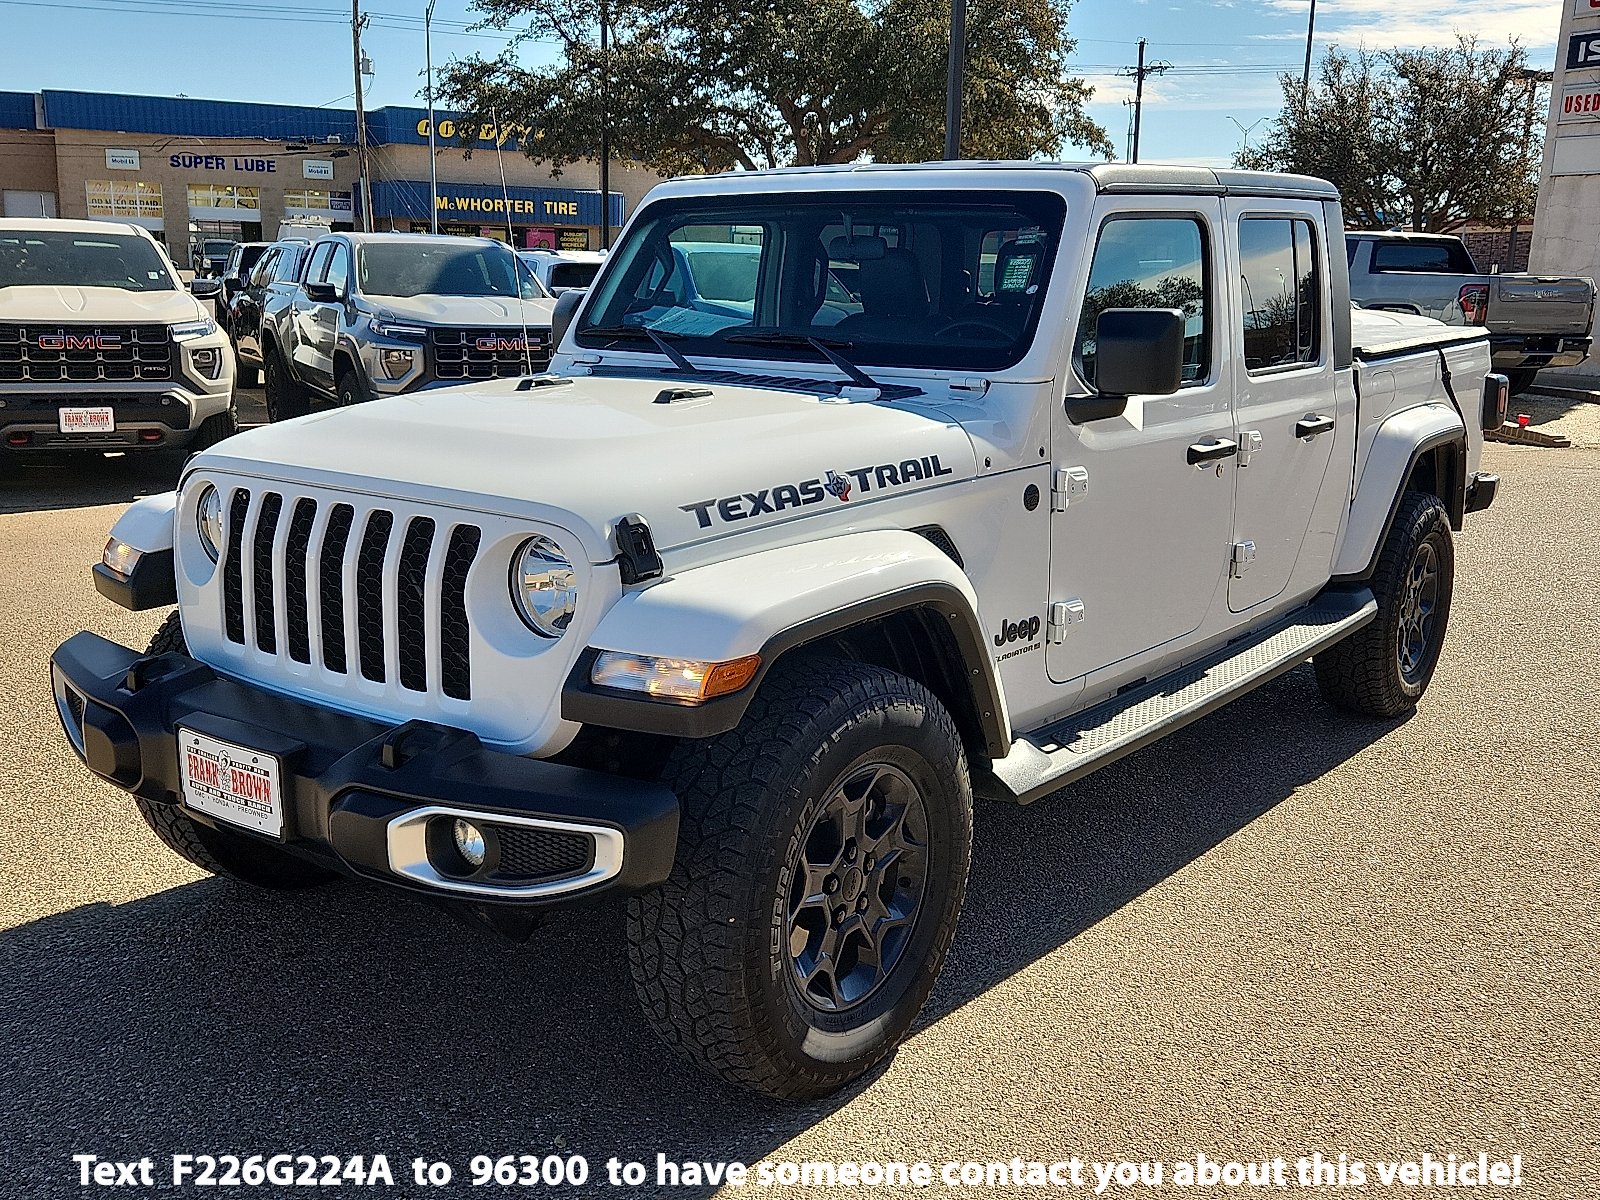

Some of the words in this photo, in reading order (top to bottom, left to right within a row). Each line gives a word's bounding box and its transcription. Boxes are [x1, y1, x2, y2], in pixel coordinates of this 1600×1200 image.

[1564, 93, 1600, 114] USED
[169, 154, 226, 171] SUPER
[234, 157, 277, 173] LUBE
[544, 201, 578, 216] TIRE
[39, 335, 121, 350] GMC
[475, 337, 542, 351] GMC
[64, 414, 84, 423] FRANK
[89, 414, 109, 423] BROWN
[678, 478, 825, 529] TEXAS
[845, 454, 953, 493] TRAIL
[994, 615, 1041, 647] Jeep
[187, 753, 220, 788] FRANK
[231, 768, 272, 804] BROWN
[191, 781, 208, 791] AUTO
[208, 788, 222, 797] AND
[224, 793, 246, 805] TRUCK
[247, 800, 271, 812] RANCH
[237, 805, 269, 820] PREOWNED
